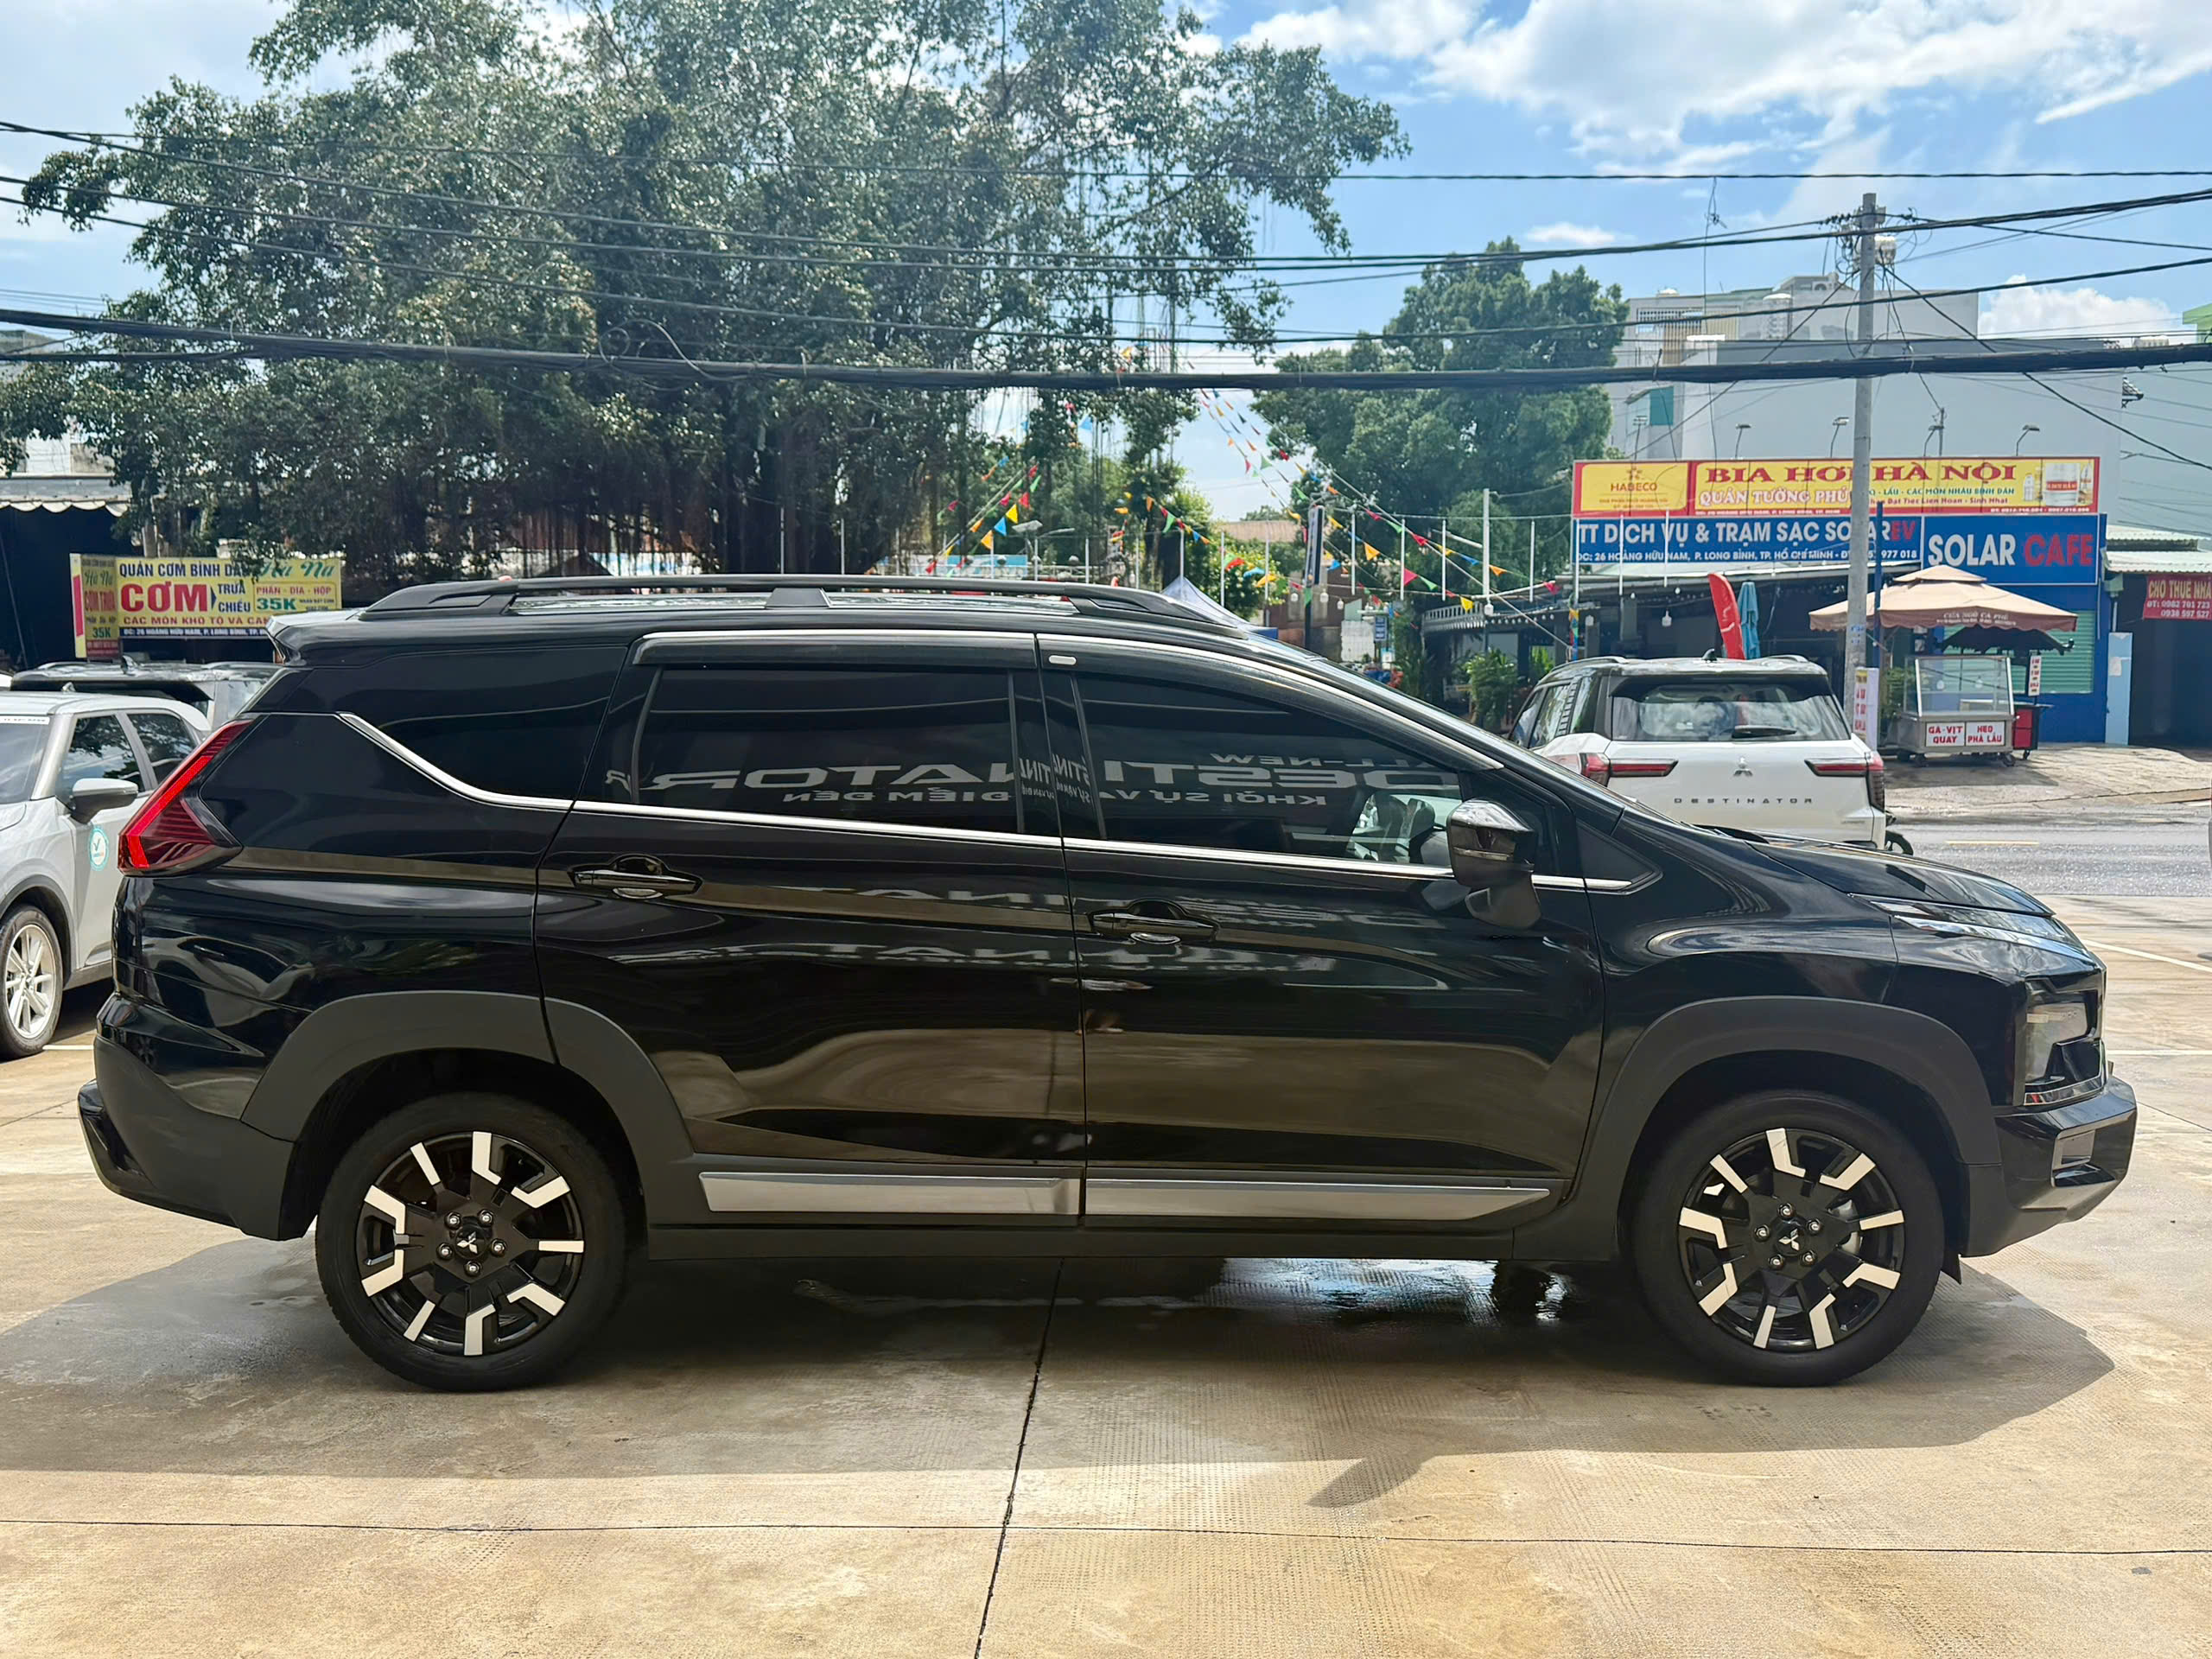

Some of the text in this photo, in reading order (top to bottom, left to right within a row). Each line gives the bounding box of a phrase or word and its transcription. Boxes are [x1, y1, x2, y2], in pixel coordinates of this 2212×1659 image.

[1706, 467, 1775, 482] BIA
[1872, 461, 1932, 481] HÀ
[1941, 461, 2017, 484] NỘI
[1611, 482, 1657, 492] HABECO
[1605, 523, 1655, 546] DCH
[1662, 523, 1688, 547] VỤ
[1695, 523, 1710, 543] &
[1715, 522, 1770, 547] TRẠM
[1777, 521, 1820, 546] SẠC
[1595, 552, 1606, 562] 26
[1608, 550, 1643, 562] HOÀNG
[1694, 551, 1702, 560] P.
[1704, 551, 1731, 560] LONG
[1760, 551, 1772, 560] TP.
[1881, 550, 1898, 559] 977
[1900, 550, 1917, 559] 018
[1928, 532, 2094, 567] SOLAR CAFE
[190, 561, 220, 577] BÌNH
[121, 581, 208, 613] CƠM
[257, 597, 296, 611] 35K
[181, 615, 205, 625] KHO
[1976, 725, 1993, 734] HEO
[1933, 735, 1958, 744] QUAY
